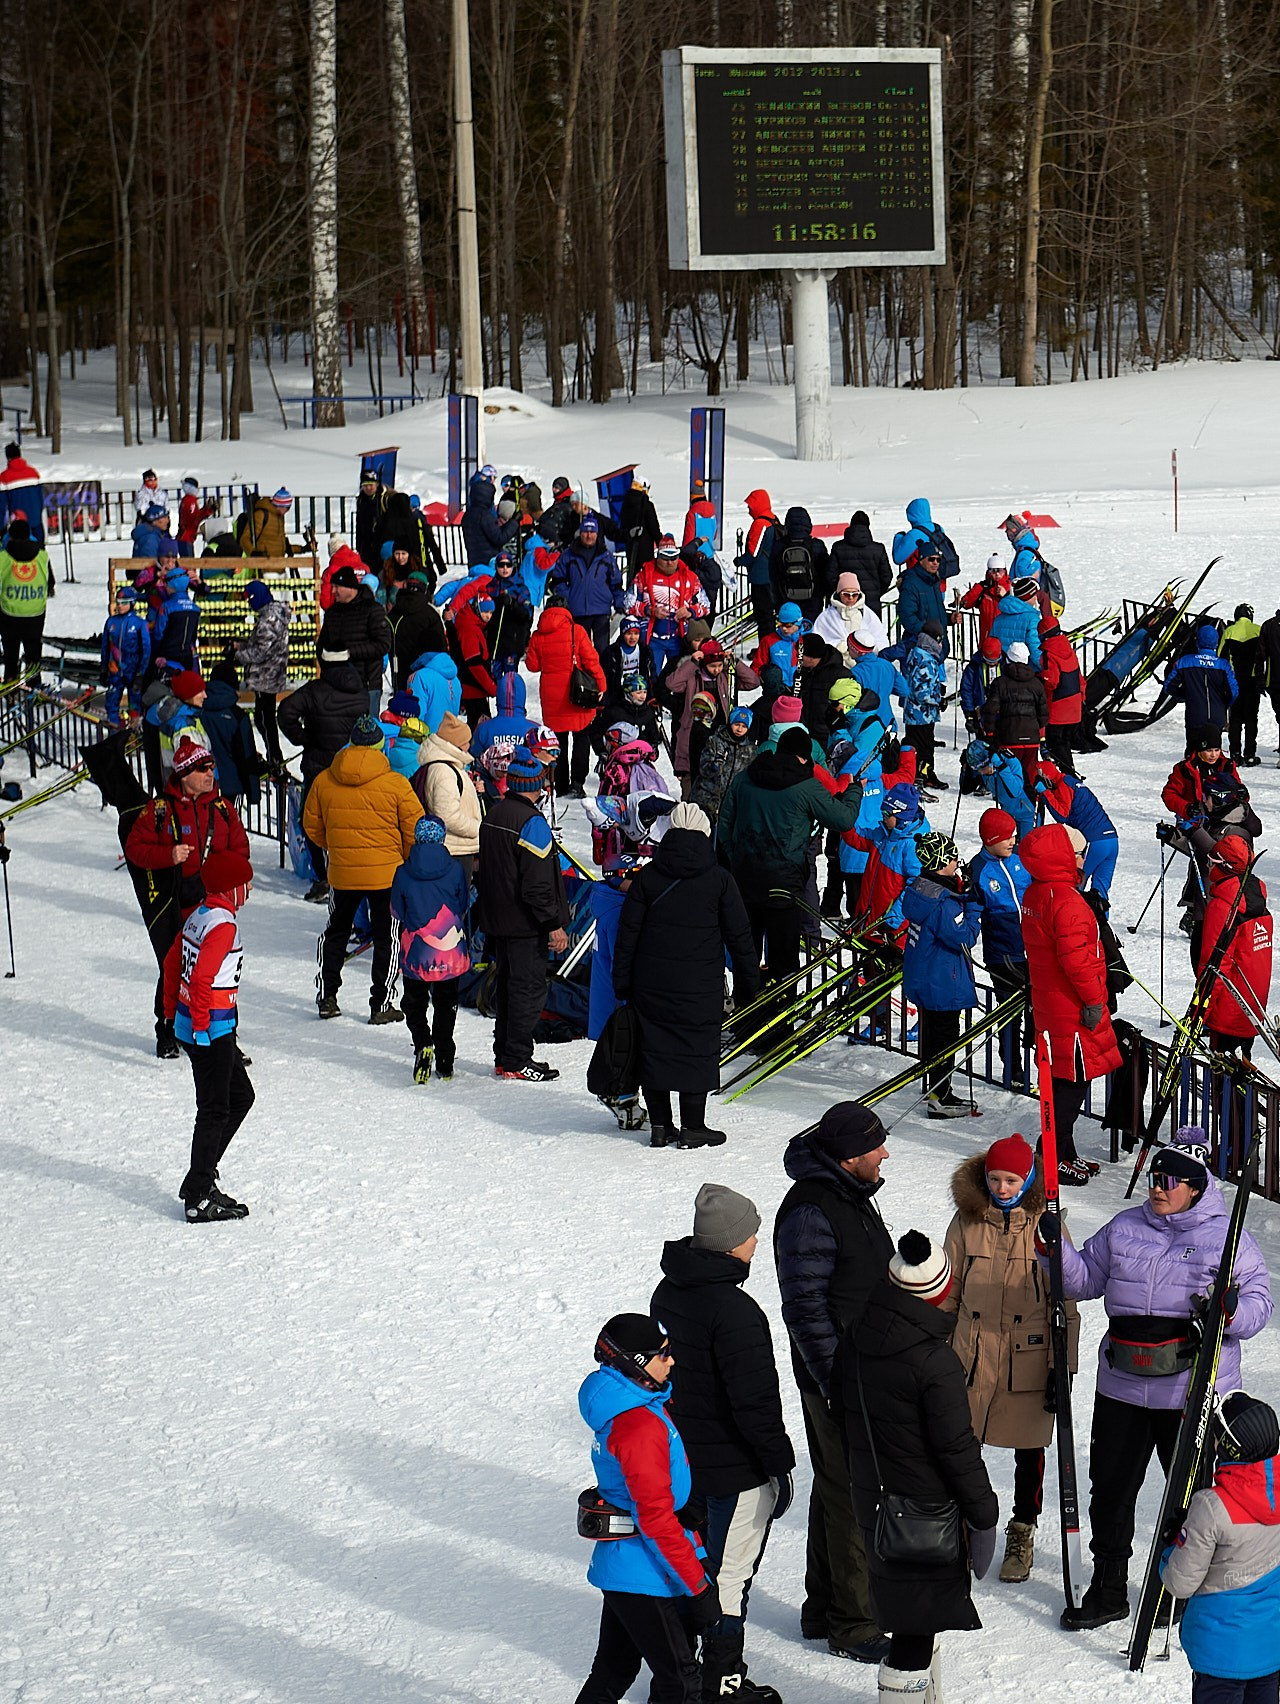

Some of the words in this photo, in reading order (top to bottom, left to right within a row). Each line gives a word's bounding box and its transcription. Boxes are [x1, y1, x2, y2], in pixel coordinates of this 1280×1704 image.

[772, 222, 877, 242] 11:58:16
[6, 584, 43, 600] СУДЬЯ
[494, 735, 525, 746] RUSSIA
[1043, 1099, 1052, 1134] ATOMIC
[1057, 1161, 1087, 1180] pina
[1194, 1381, 1213, 1449] FISCHER
